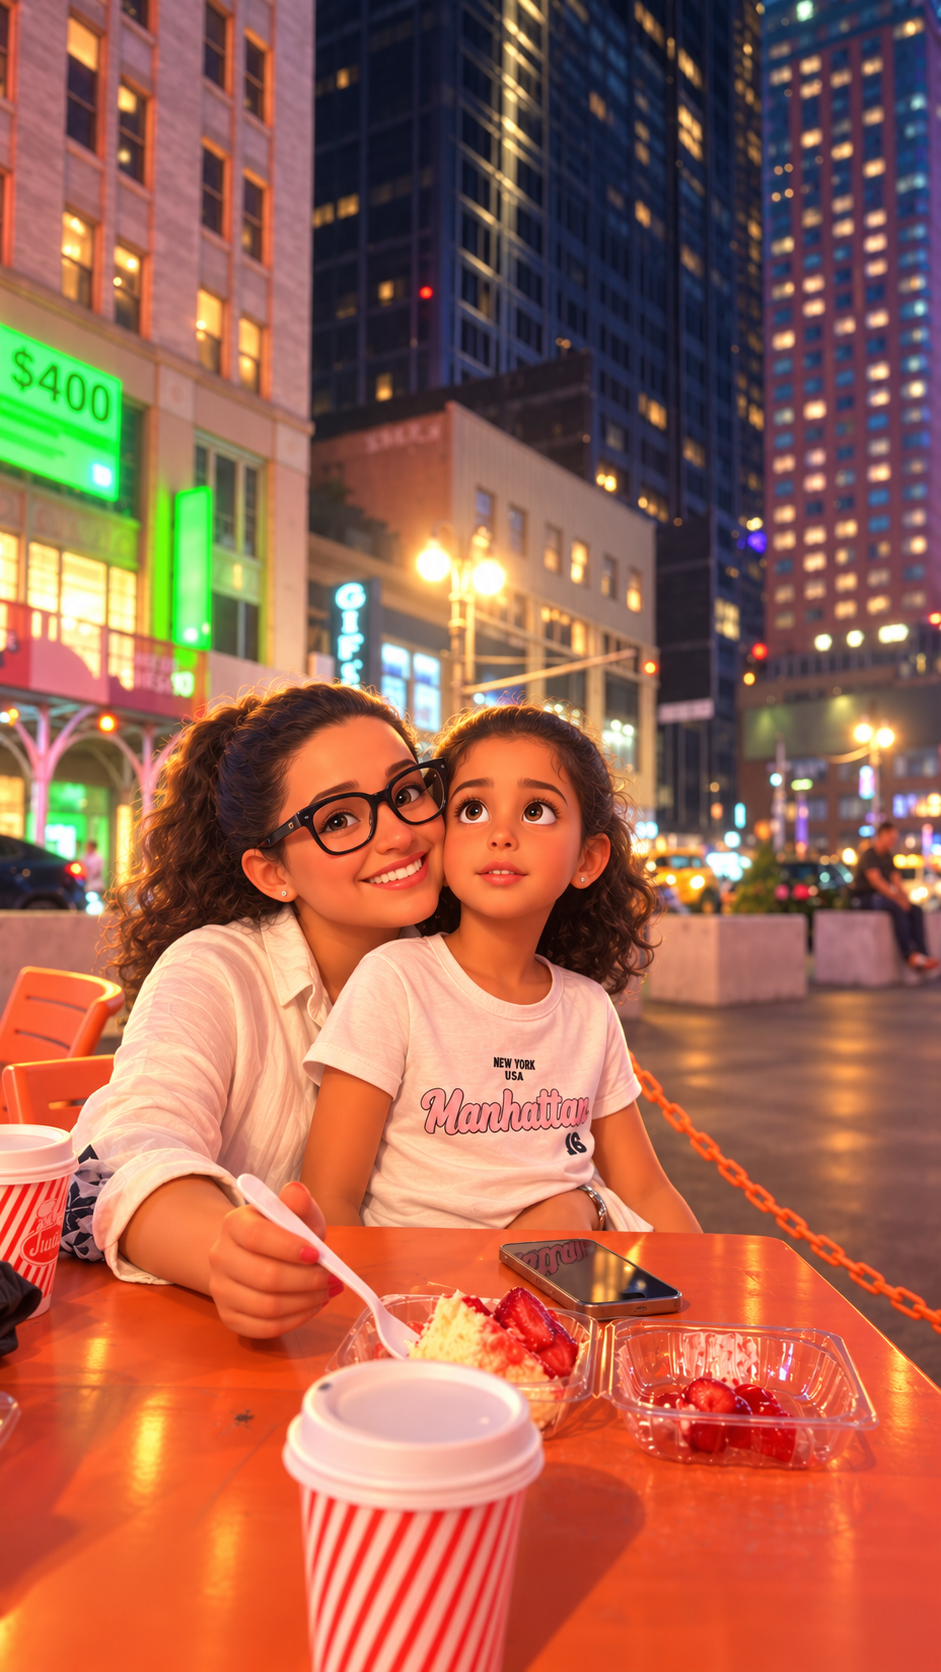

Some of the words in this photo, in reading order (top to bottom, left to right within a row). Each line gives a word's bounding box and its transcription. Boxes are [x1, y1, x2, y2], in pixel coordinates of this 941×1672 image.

[12, 348, 110, 421] $400
[494, 1057, 512, 1069] NEW
[515, 1059, 536, 1070] YORK
[505, 1071, 524, 1081] USA
[566, 1132, 587, 1156] 16
